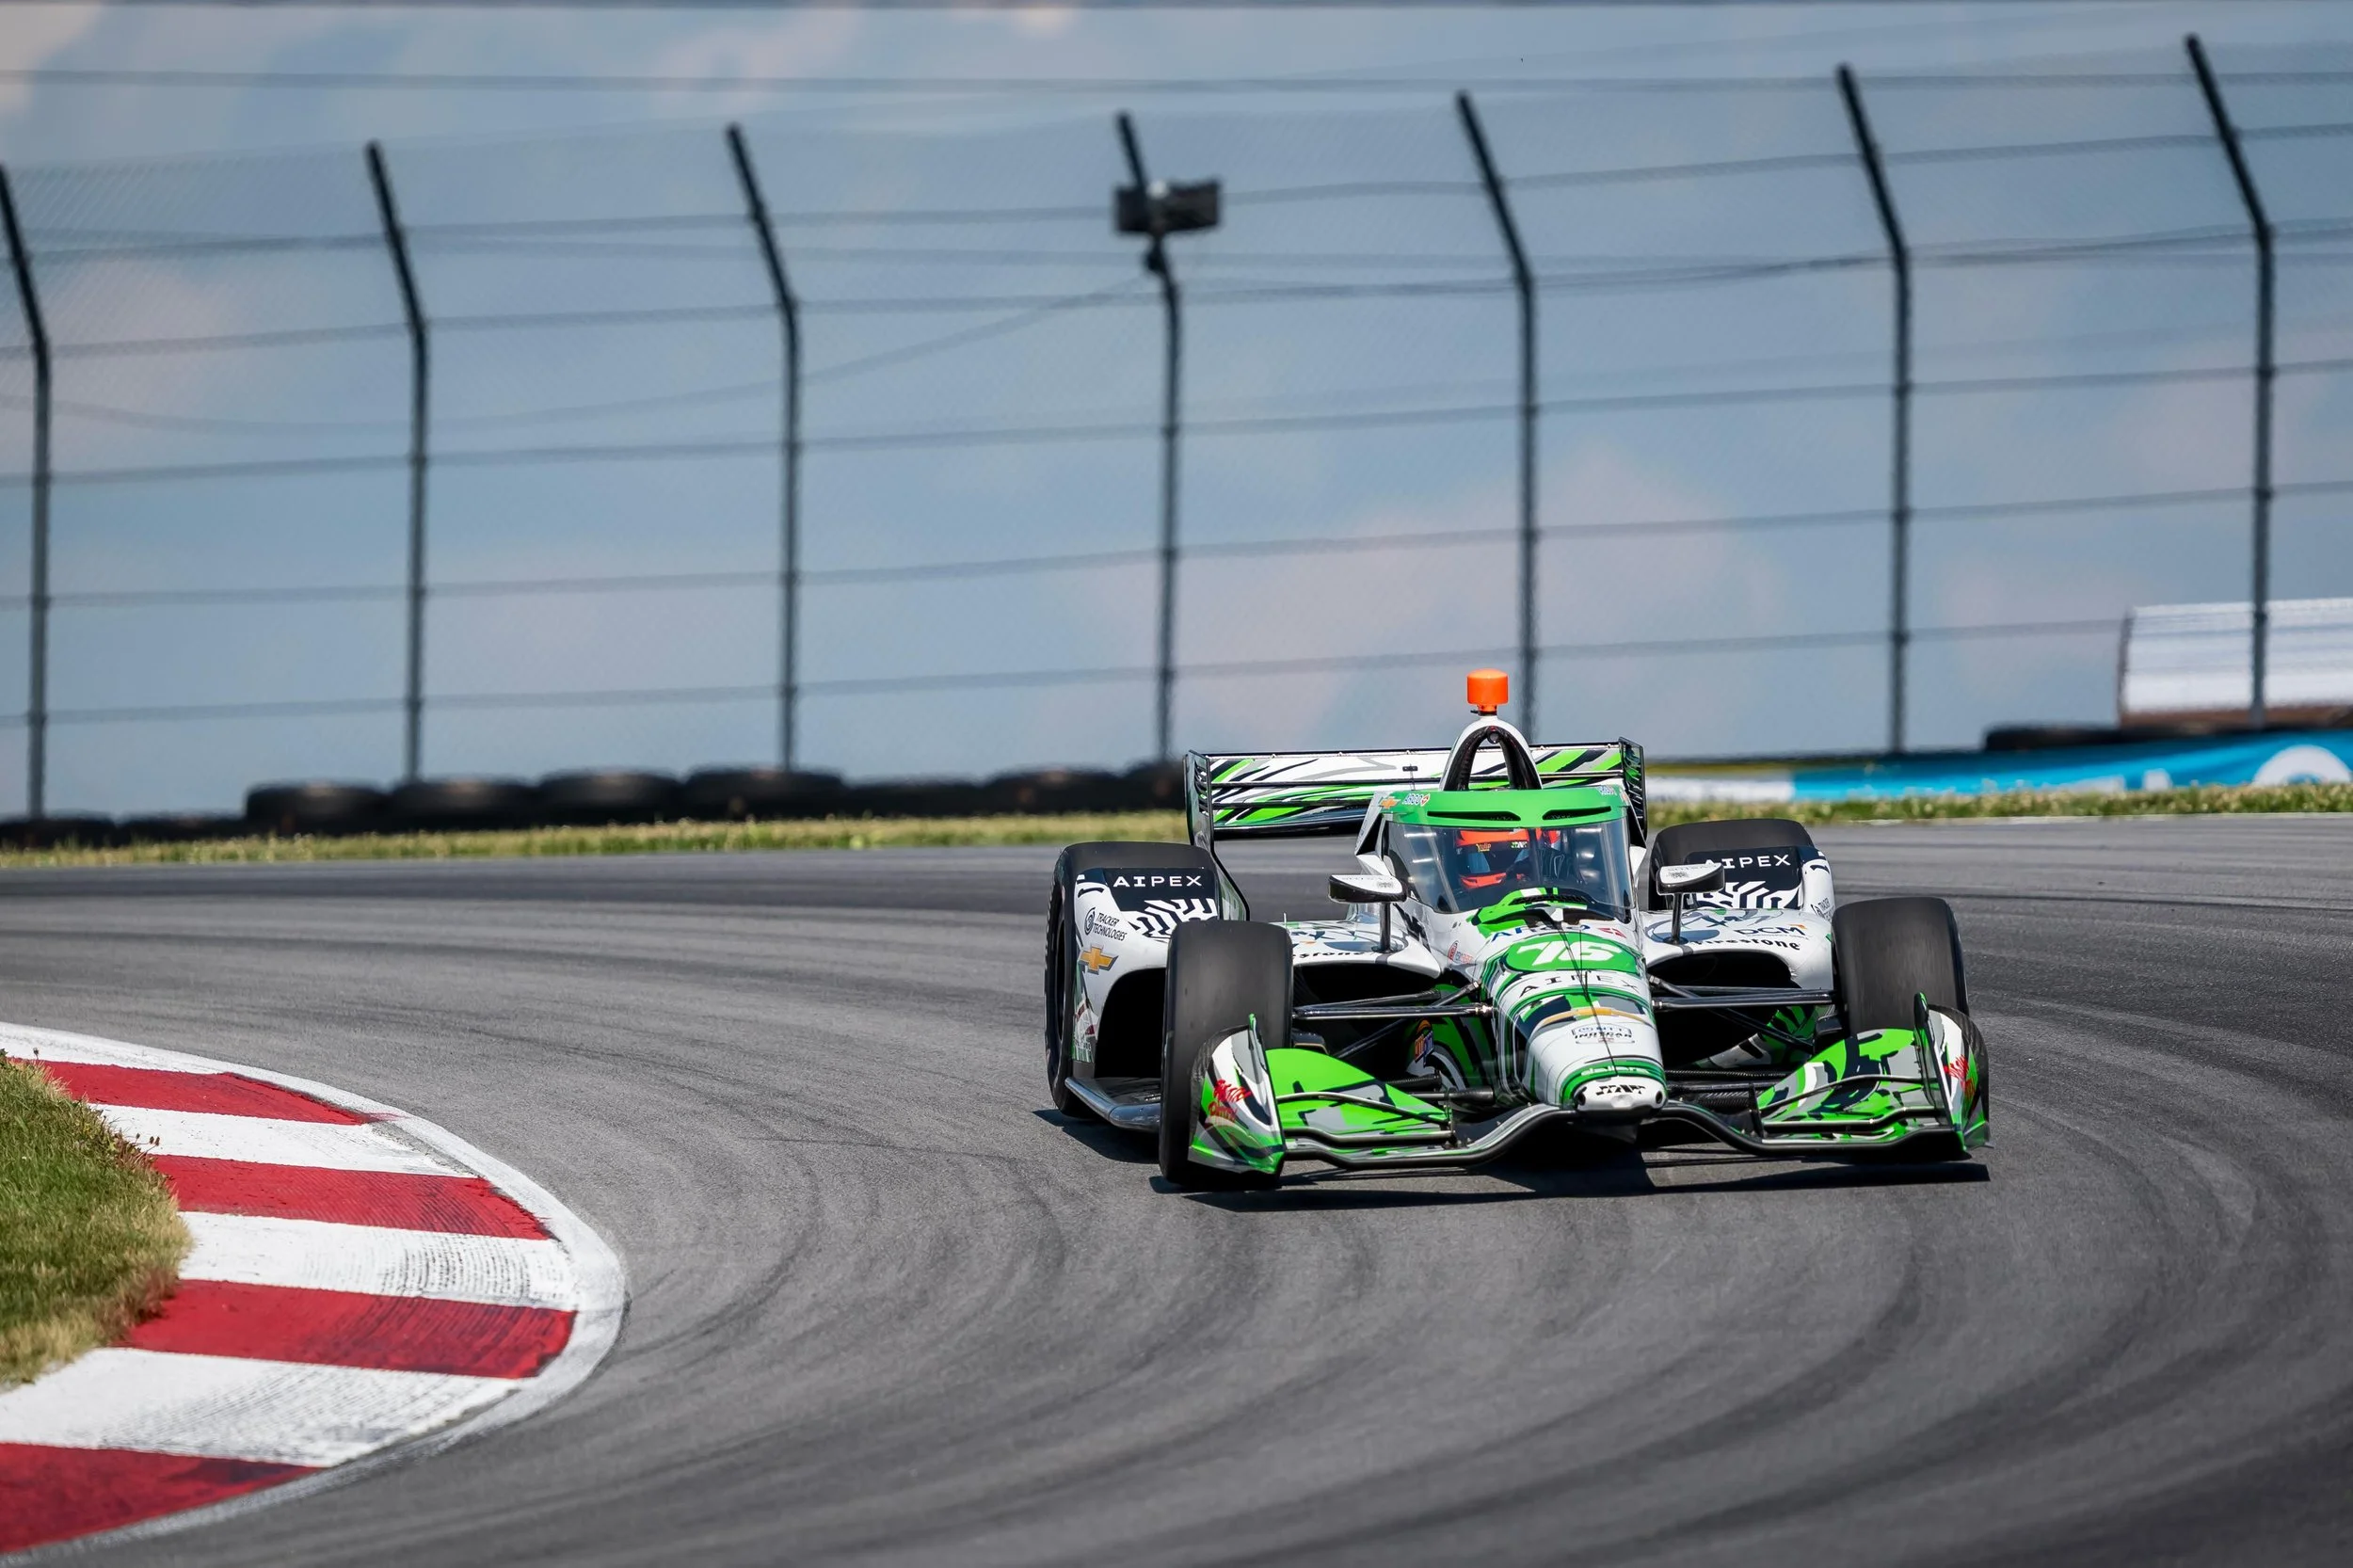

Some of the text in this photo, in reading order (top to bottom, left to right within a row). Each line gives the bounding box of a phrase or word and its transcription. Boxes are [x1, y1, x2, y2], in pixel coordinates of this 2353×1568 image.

[1112, 875, 1203, 888] AIPEX
[1096, 912, 1120, 927] TRACKER
[1092, 922, 1128, 941] TECHNOLOGIES
[1734, 926, 1806, 936] DCM
